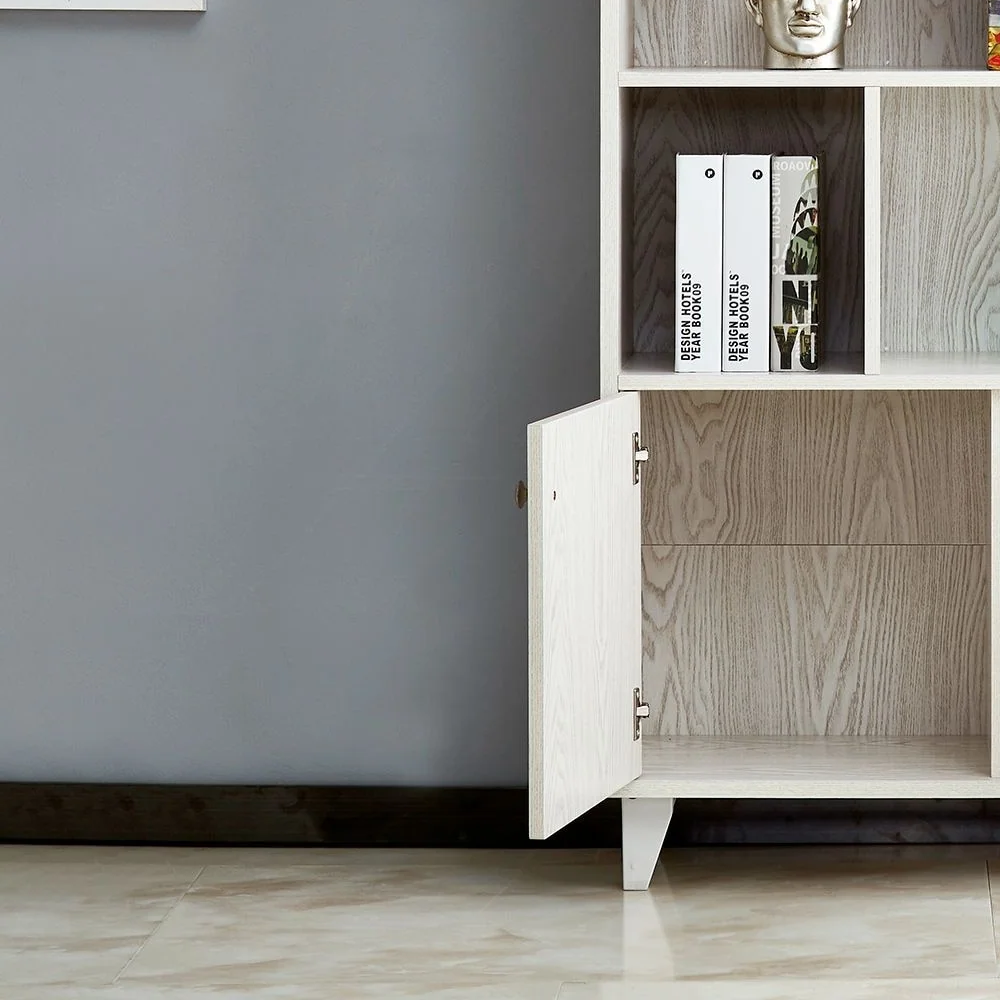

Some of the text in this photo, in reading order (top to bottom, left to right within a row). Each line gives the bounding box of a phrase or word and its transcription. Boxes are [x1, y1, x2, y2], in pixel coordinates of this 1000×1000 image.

[681, 273, 692, 361] DESIGN HOTELS
[691, 283, 702, 361] YEAR BOOK09
[729, 274, 740, 362] DESIGN HOTELS
[739, 284, 750, 362] YEAR BOOK09
